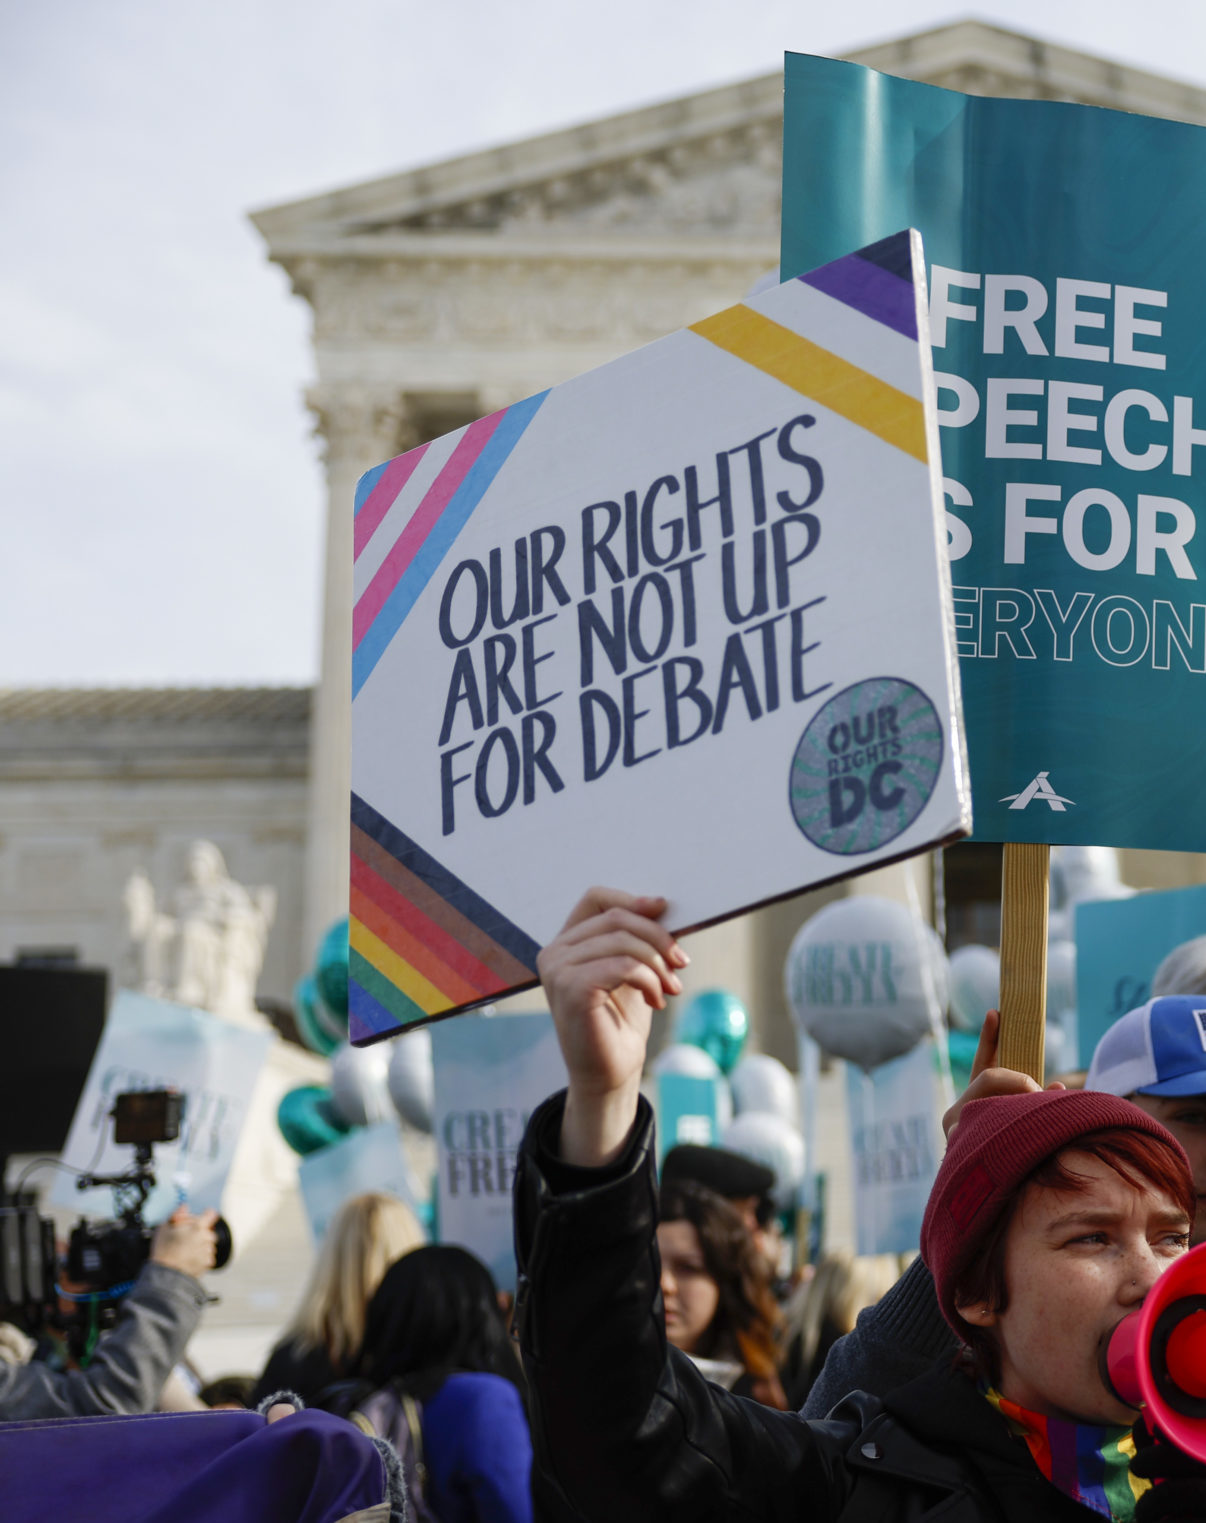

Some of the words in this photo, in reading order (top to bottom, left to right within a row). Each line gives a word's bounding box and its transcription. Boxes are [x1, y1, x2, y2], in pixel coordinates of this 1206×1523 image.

[929, 264, 1168, 370] FREE
[439, 525, 571, 649] OUR
[581, 414, 825, 596] RIGHTS
[1004, 482, 1198, 580] FOR
[439, 614, 563, 746] ARE
[578, 553, 706, 688] NOT
[721, 513, 821, 625] UP
[441, 711, 565, 836] FOR
[579, 596, 834, 782] DEBATE
[827, 705, 899, 755] OUR
[828, 737, 902, 777] RIGHTS
[829, 760, 906, 829] DC
[443, 1108, 528, 1152] CRE
[447, 1150, 517, 1198] FRE
